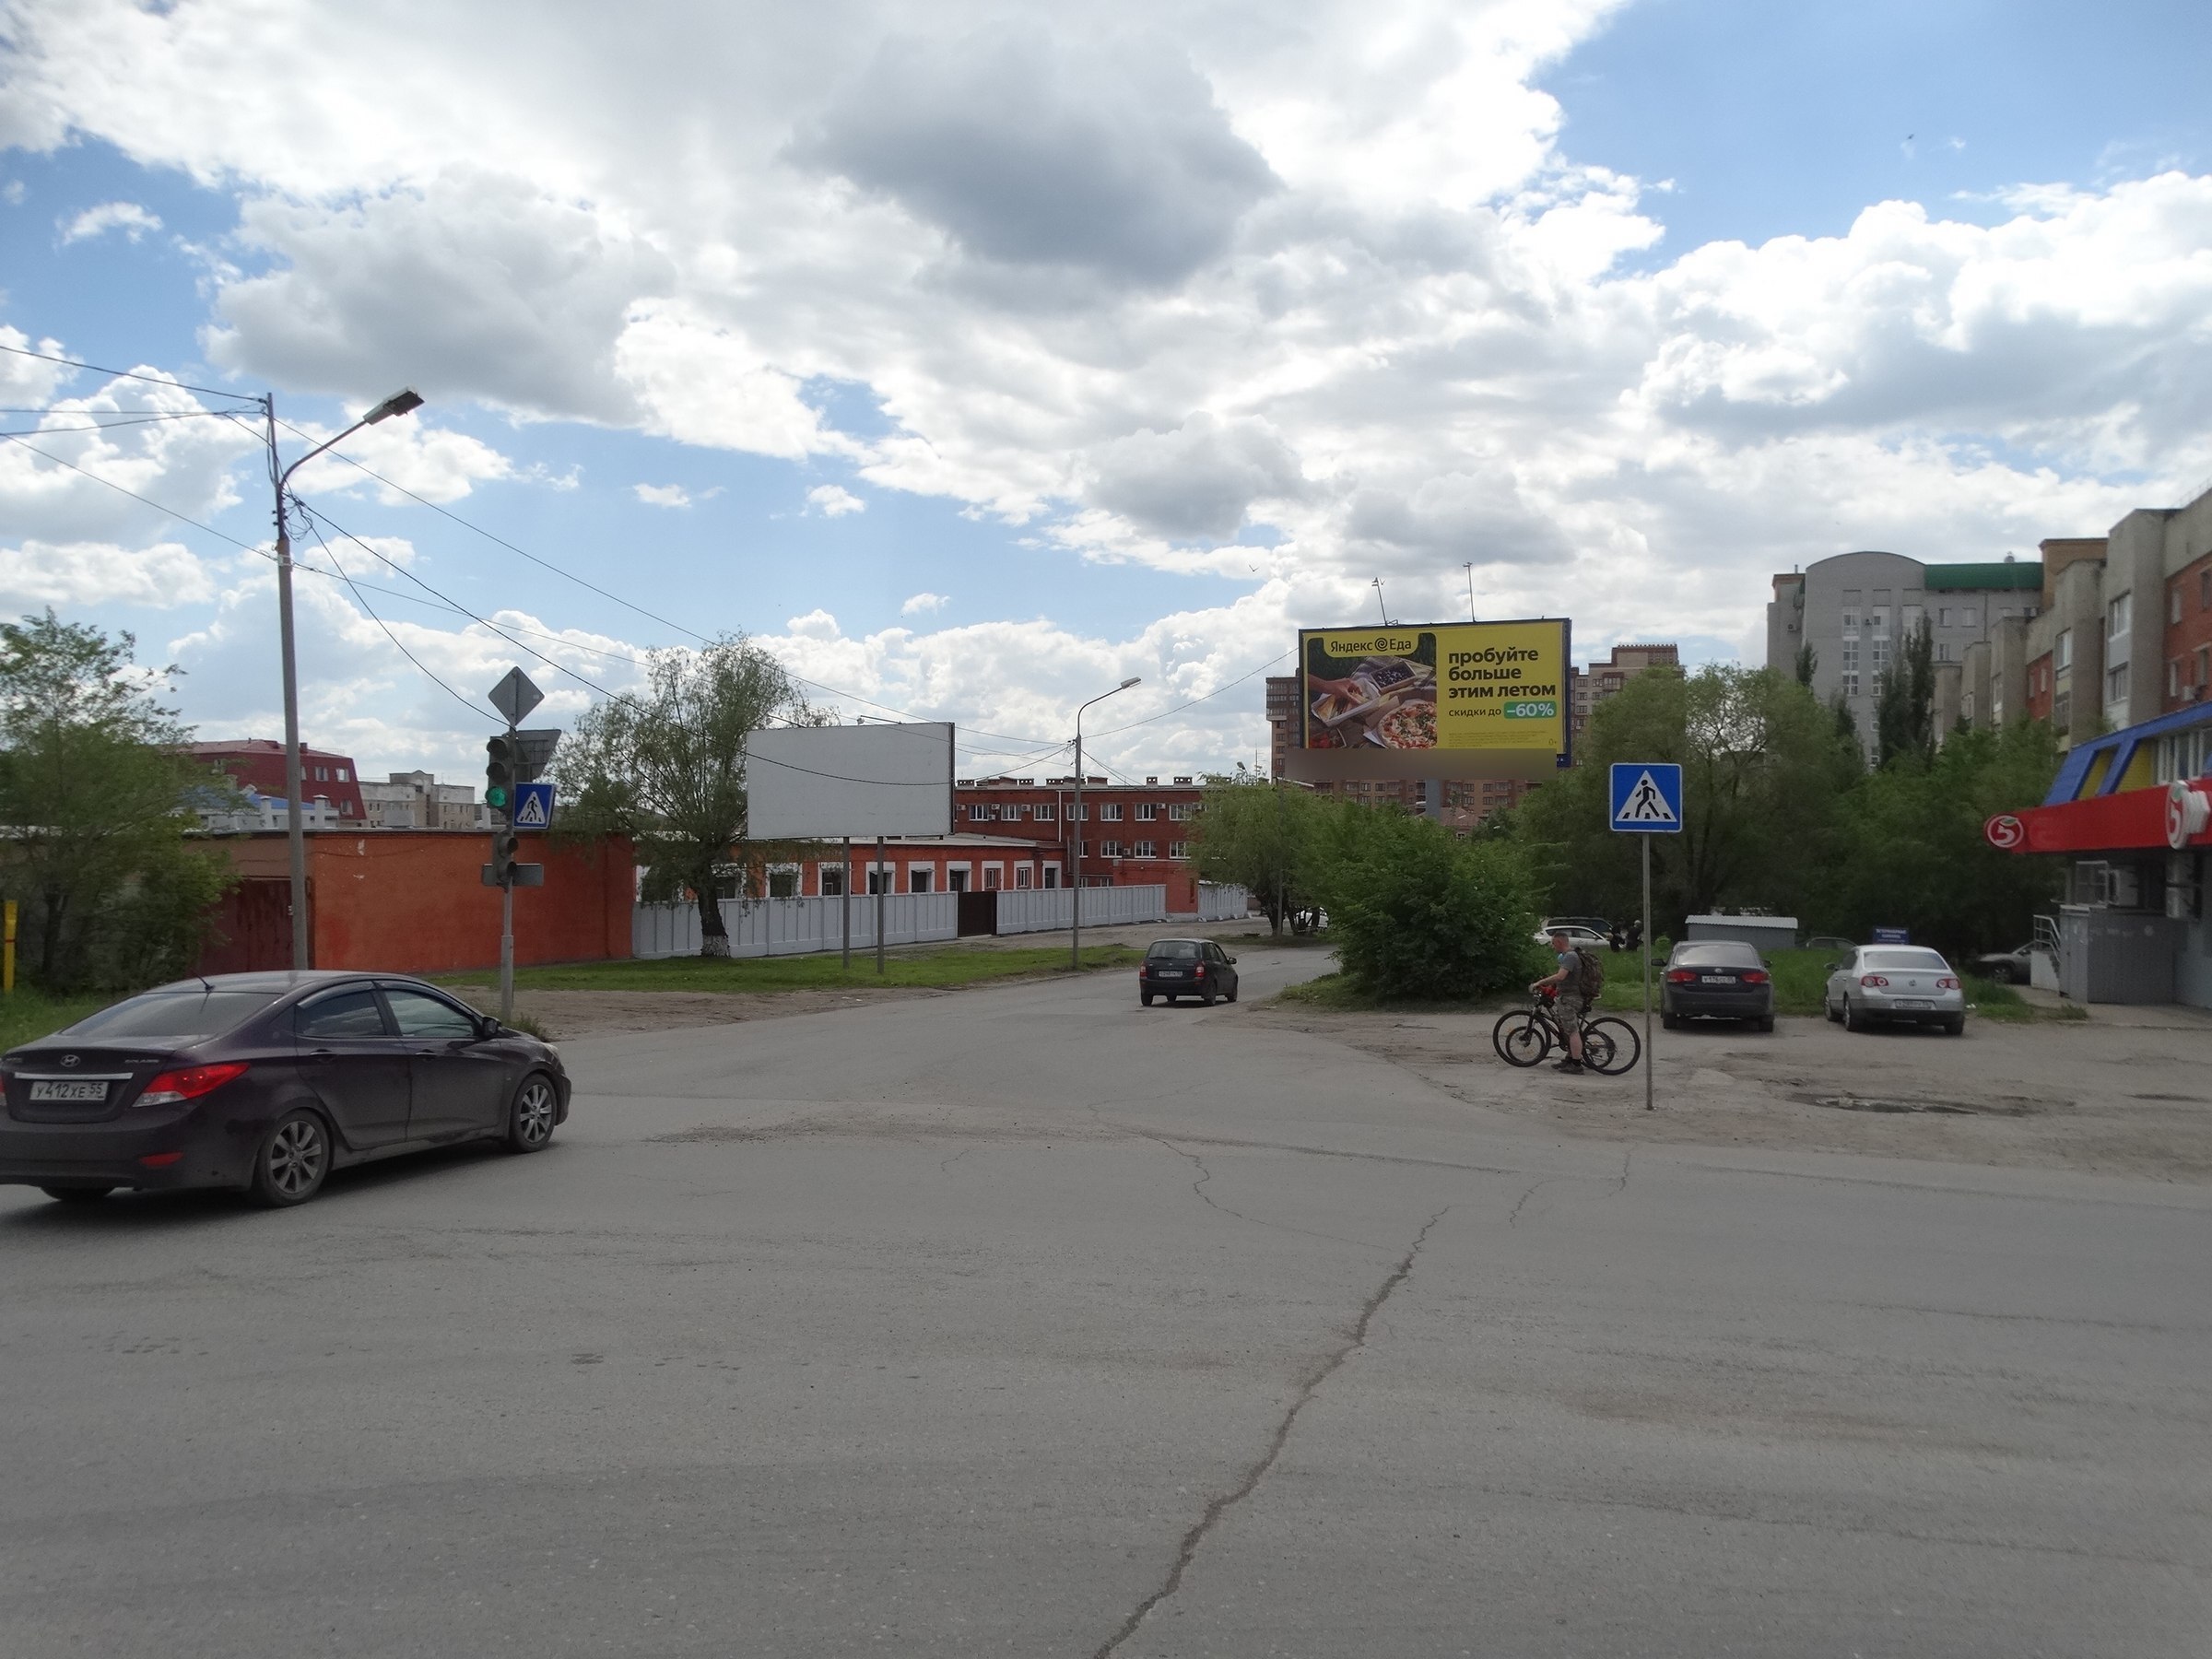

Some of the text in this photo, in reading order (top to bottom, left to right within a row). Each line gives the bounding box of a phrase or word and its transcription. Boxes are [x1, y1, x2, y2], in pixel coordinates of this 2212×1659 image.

[1330, 638, 1412, 653] Яндекс Еда
[1448, 646, 1539, 666] пробуйте
[1448, 665, 1522, 681] больше
[1448, 684, 1556, 699] этим летом
[1448, 708, 1487, 718] скидки
[1488, 708, 1502, 717] до
